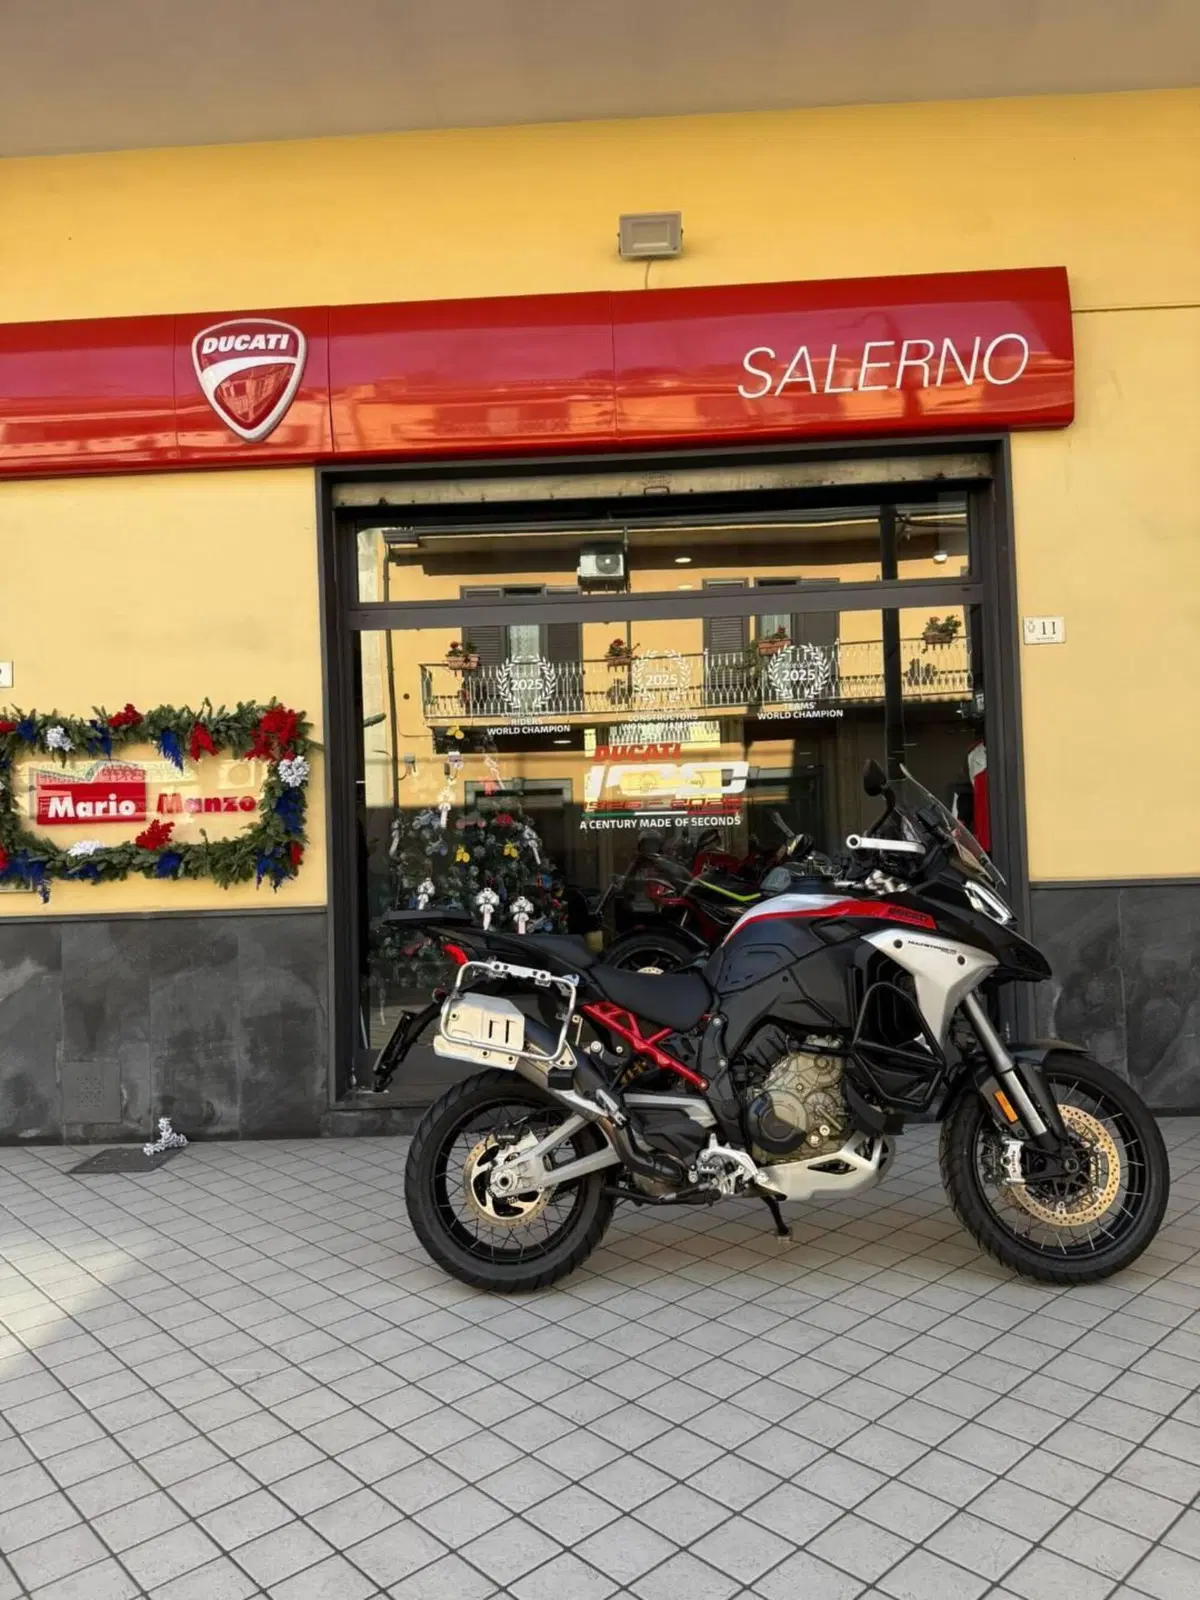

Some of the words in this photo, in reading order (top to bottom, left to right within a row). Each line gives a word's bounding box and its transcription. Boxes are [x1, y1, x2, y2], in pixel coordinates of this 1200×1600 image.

[202, 334, 290, 355] DUCATI
[737, 333, 1030, 399] SALERNO
[1041, 621, 1056, 635] 11
[645, 674, 678, 686] 2025
[782, 669, 816, 681] 2025
[510, 679, 543, 690] 2025
[756, 711, 791, 720] WORLD
[793, 709, 844, 719] CHAMPION
[487, 726, 520, 736] WORLD
[521, 724, 571, 734] CHAMPION
[594, 743, 681, 761] DUCATI
[48, 793, 136, 818] Mario
[156, 792, 257, 814] Manzo
[579, 821, 587, 830] A
[589, 819, 637, 830] CENTURY
[639, 818, 672, 828] MADE
[675, 817, 690, 827] OF
[691, 815, 741, 827] SECONDS
